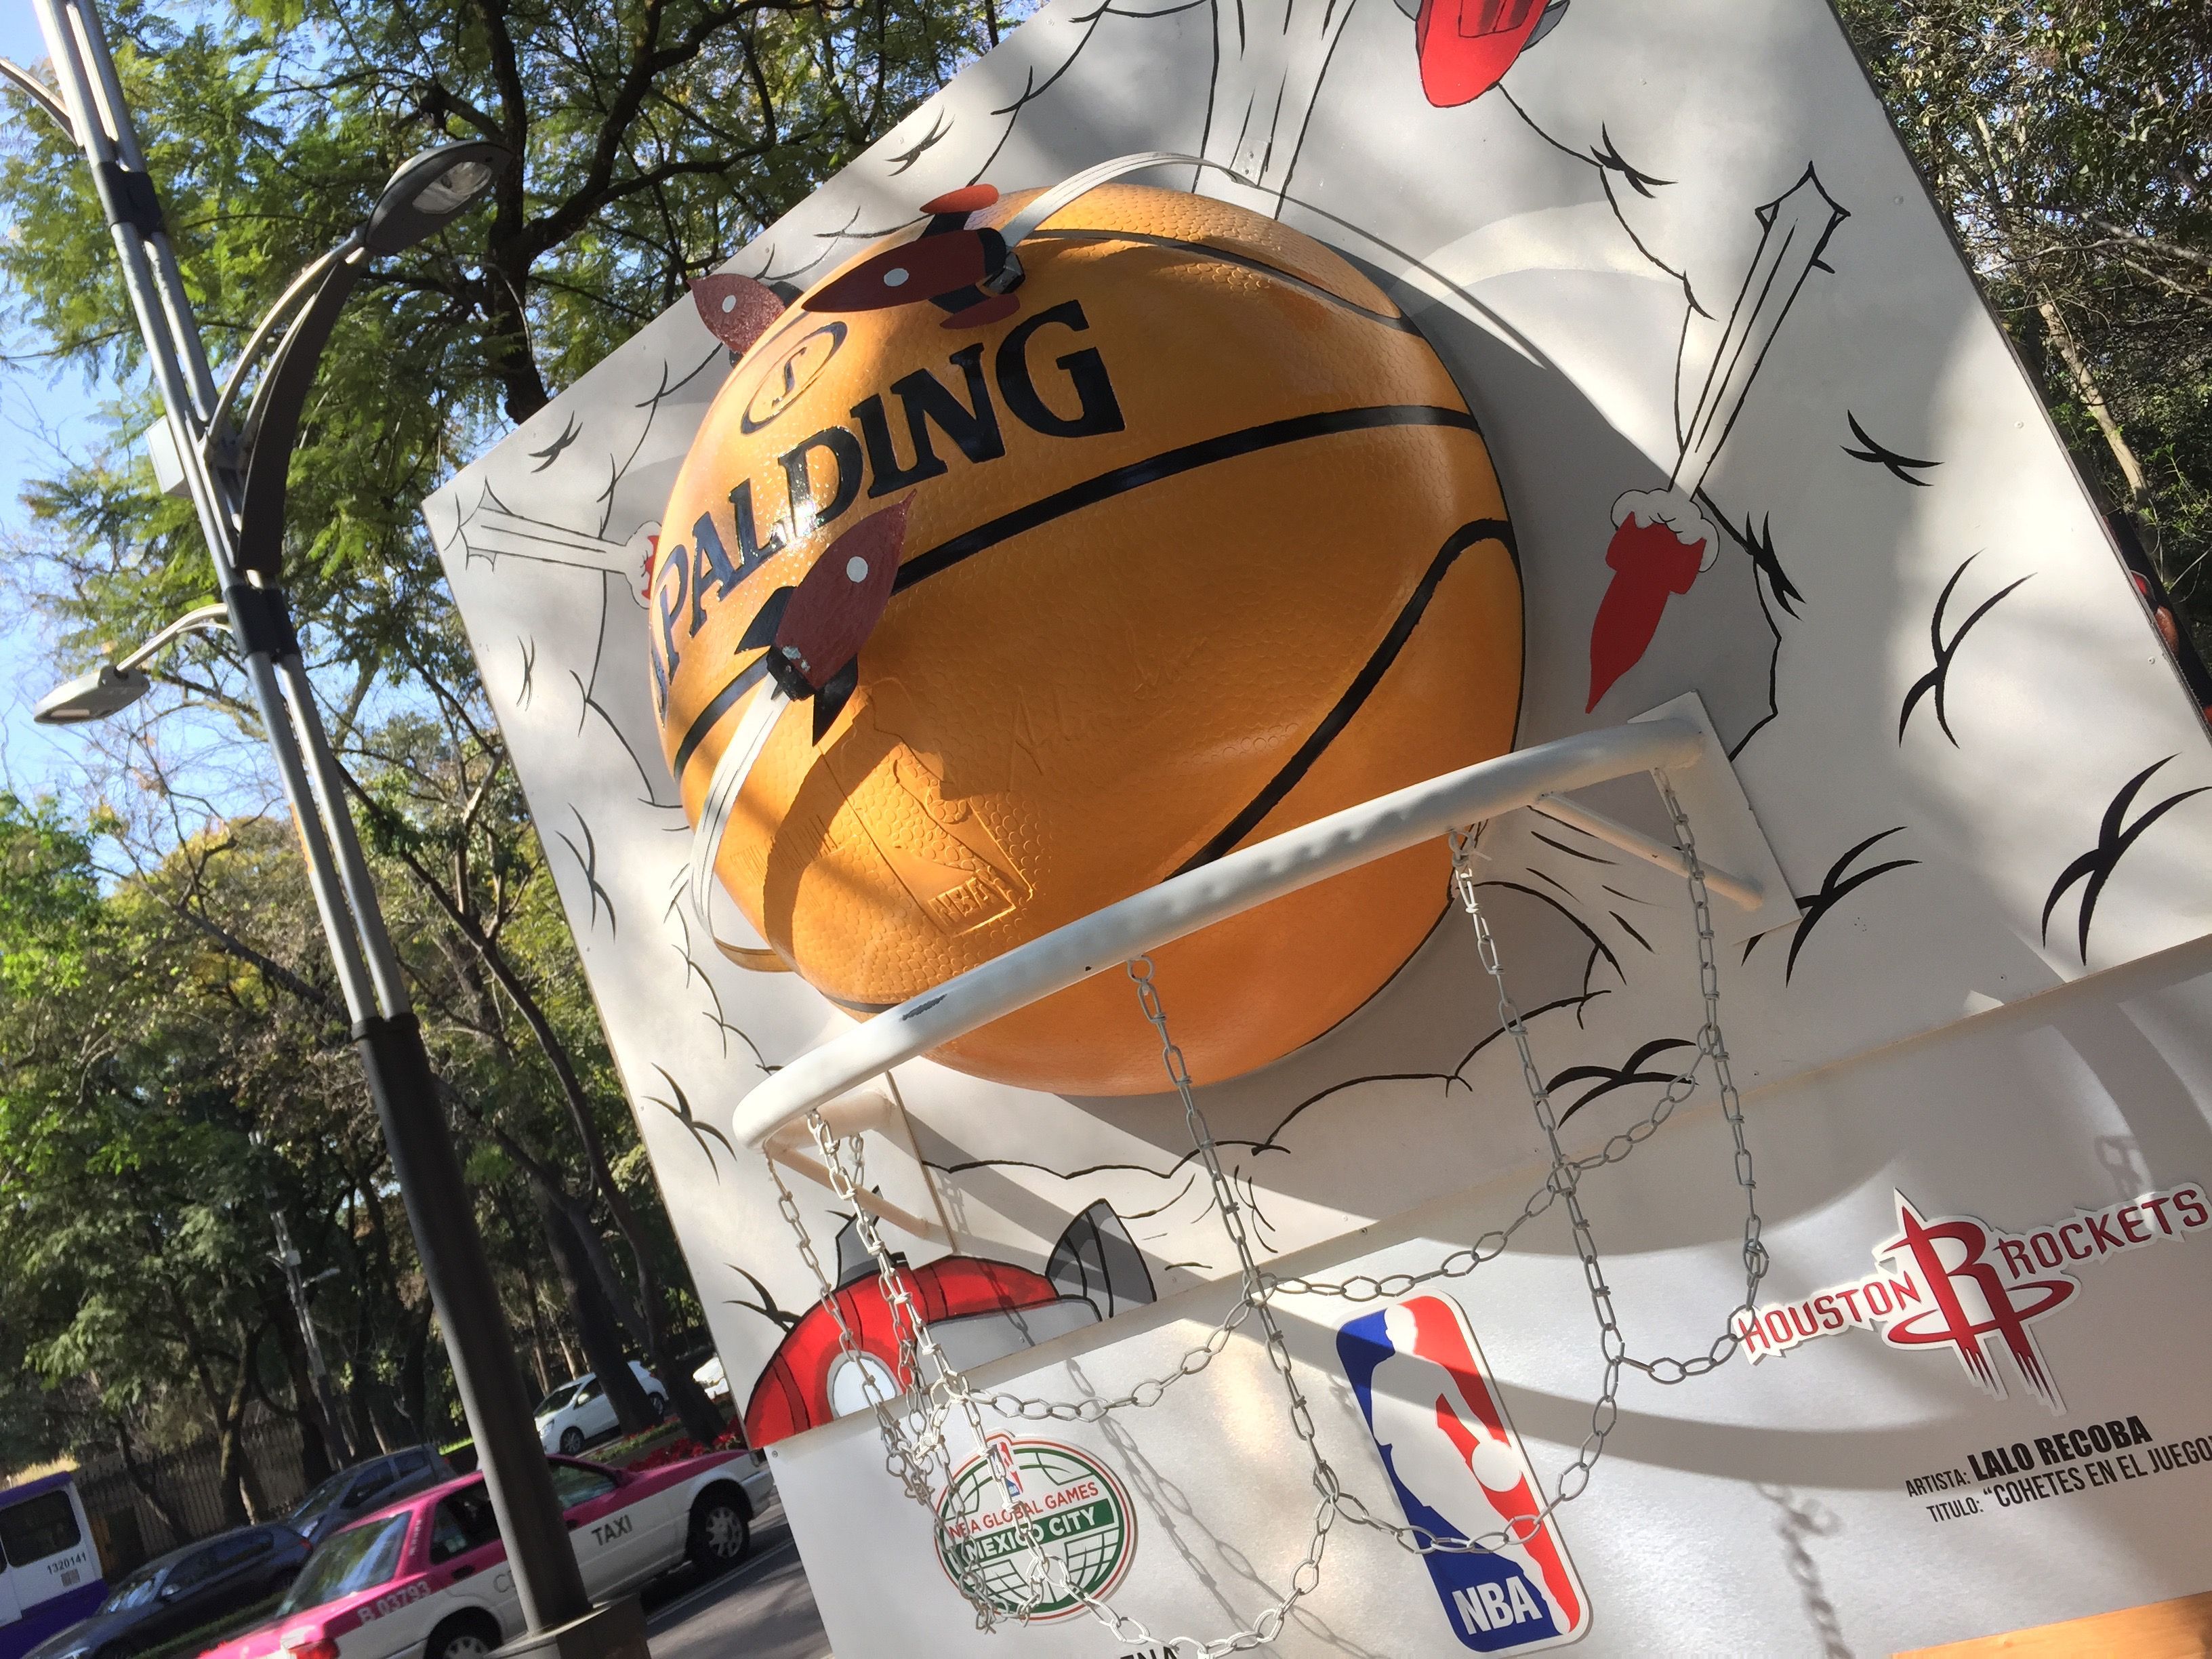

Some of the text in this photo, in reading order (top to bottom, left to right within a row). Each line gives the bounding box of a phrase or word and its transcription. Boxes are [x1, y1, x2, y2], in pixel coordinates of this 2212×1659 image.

[1992, 1189, 2209, 1279] ROCKETS
[1738, 1270, 1922, 1353] HOUSTON
[1905, 1415, 2153, 1498] ARTISTA: LALO RECOBA
[983, 1500, 1044, 1529] GLOBAL
[1044, 1481, 1099, 1509] GAMES
[1926, 1496, 1984, 1523] TITULO:
[2085, 1458, 2118, 1488] EN
[2118, 1454, 2148, 1480] EL
[592, 1514, 633, 1547] TAXI
[965, 1506, 1096, 1561] MEXICO CITY
[47, 1551, 87, 1575] 1320141
[1452, 1576, 1542, 1635] NBA
